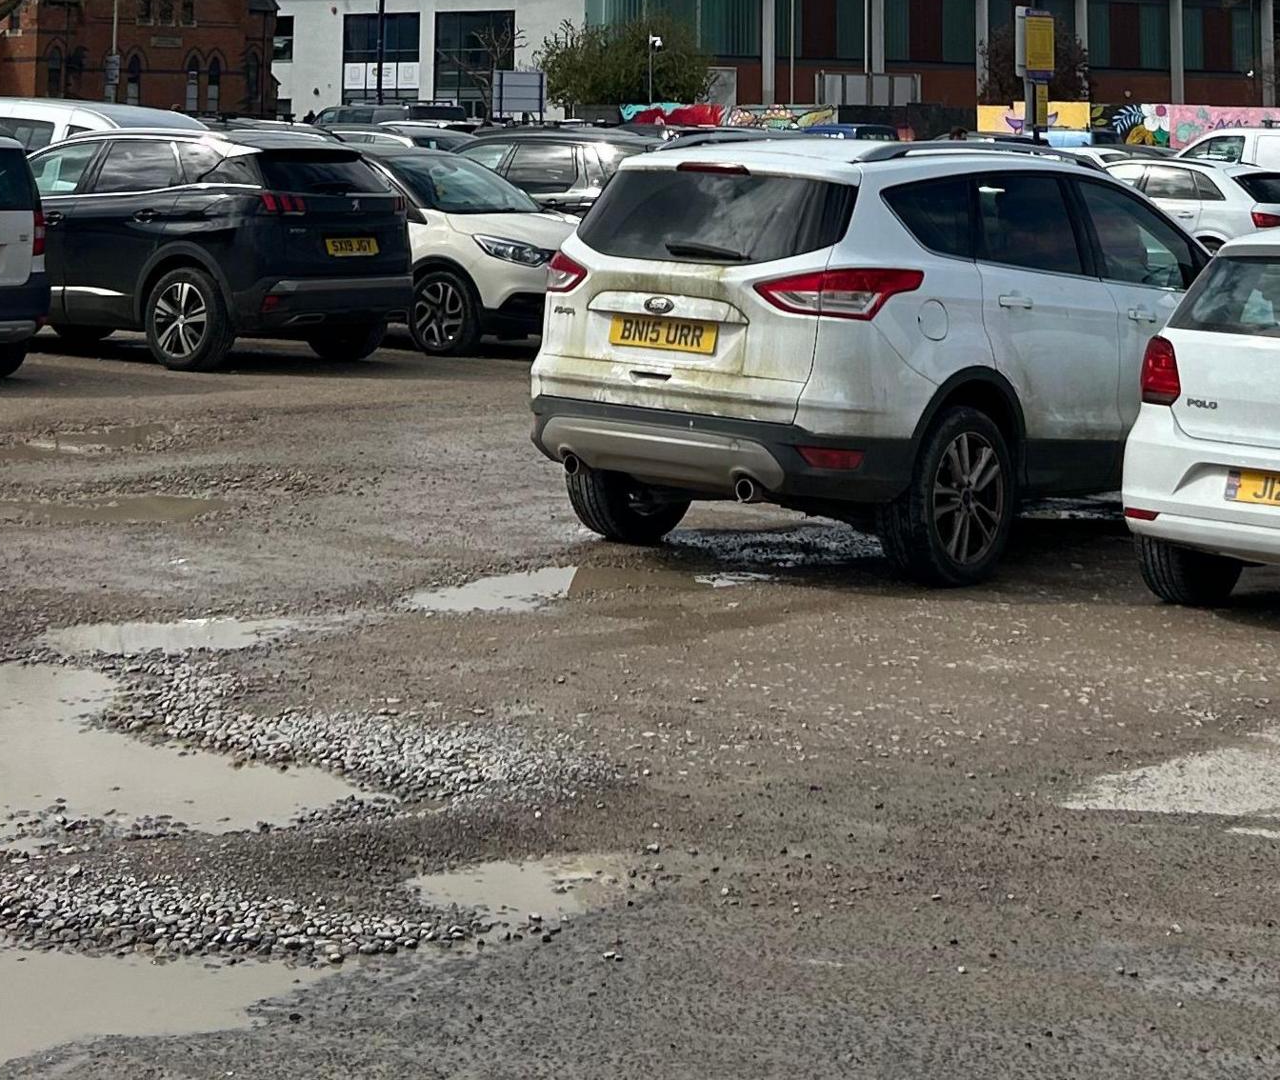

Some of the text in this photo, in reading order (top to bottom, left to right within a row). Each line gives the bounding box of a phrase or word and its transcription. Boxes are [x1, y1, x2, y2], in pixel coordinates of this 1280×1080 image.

[620, 319, 704, 348] BN15 URR
[1186, 398, 1218, 410] POLO
